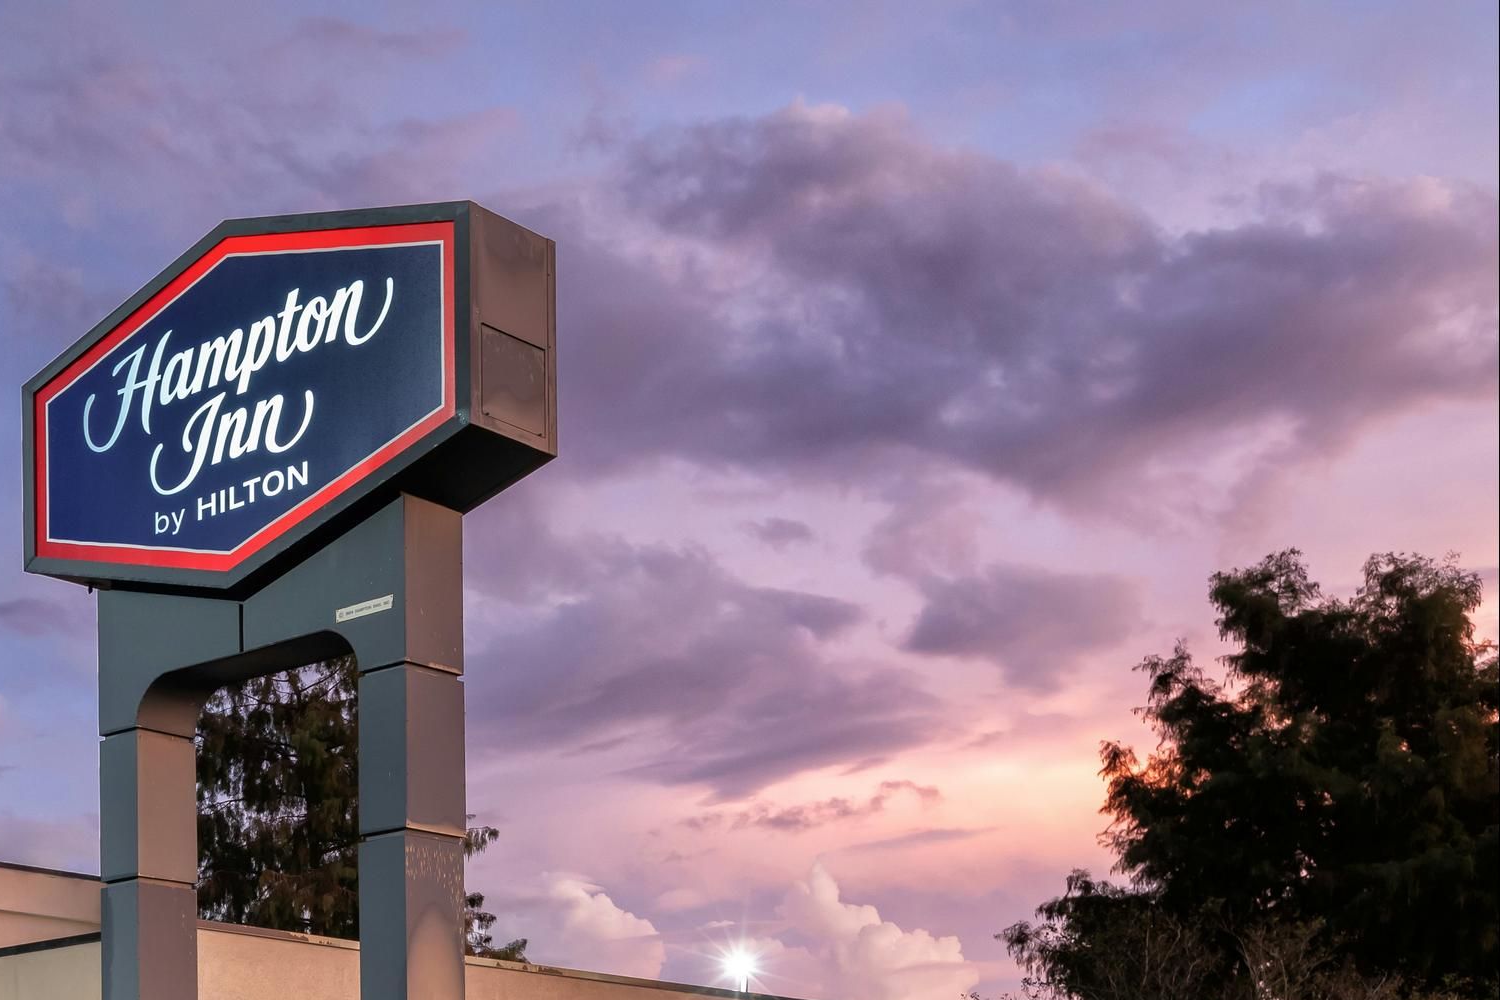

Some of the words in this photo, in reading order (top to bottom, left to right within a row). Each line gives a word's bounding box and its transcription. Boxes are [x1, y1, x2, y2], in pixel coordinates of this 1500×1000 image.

[84, 277, 393, 452] Hampton
[150, 390, 314, 495] Inn
[155, 508, 186, 536] by
[197, 461, 309, 521] HILTON
